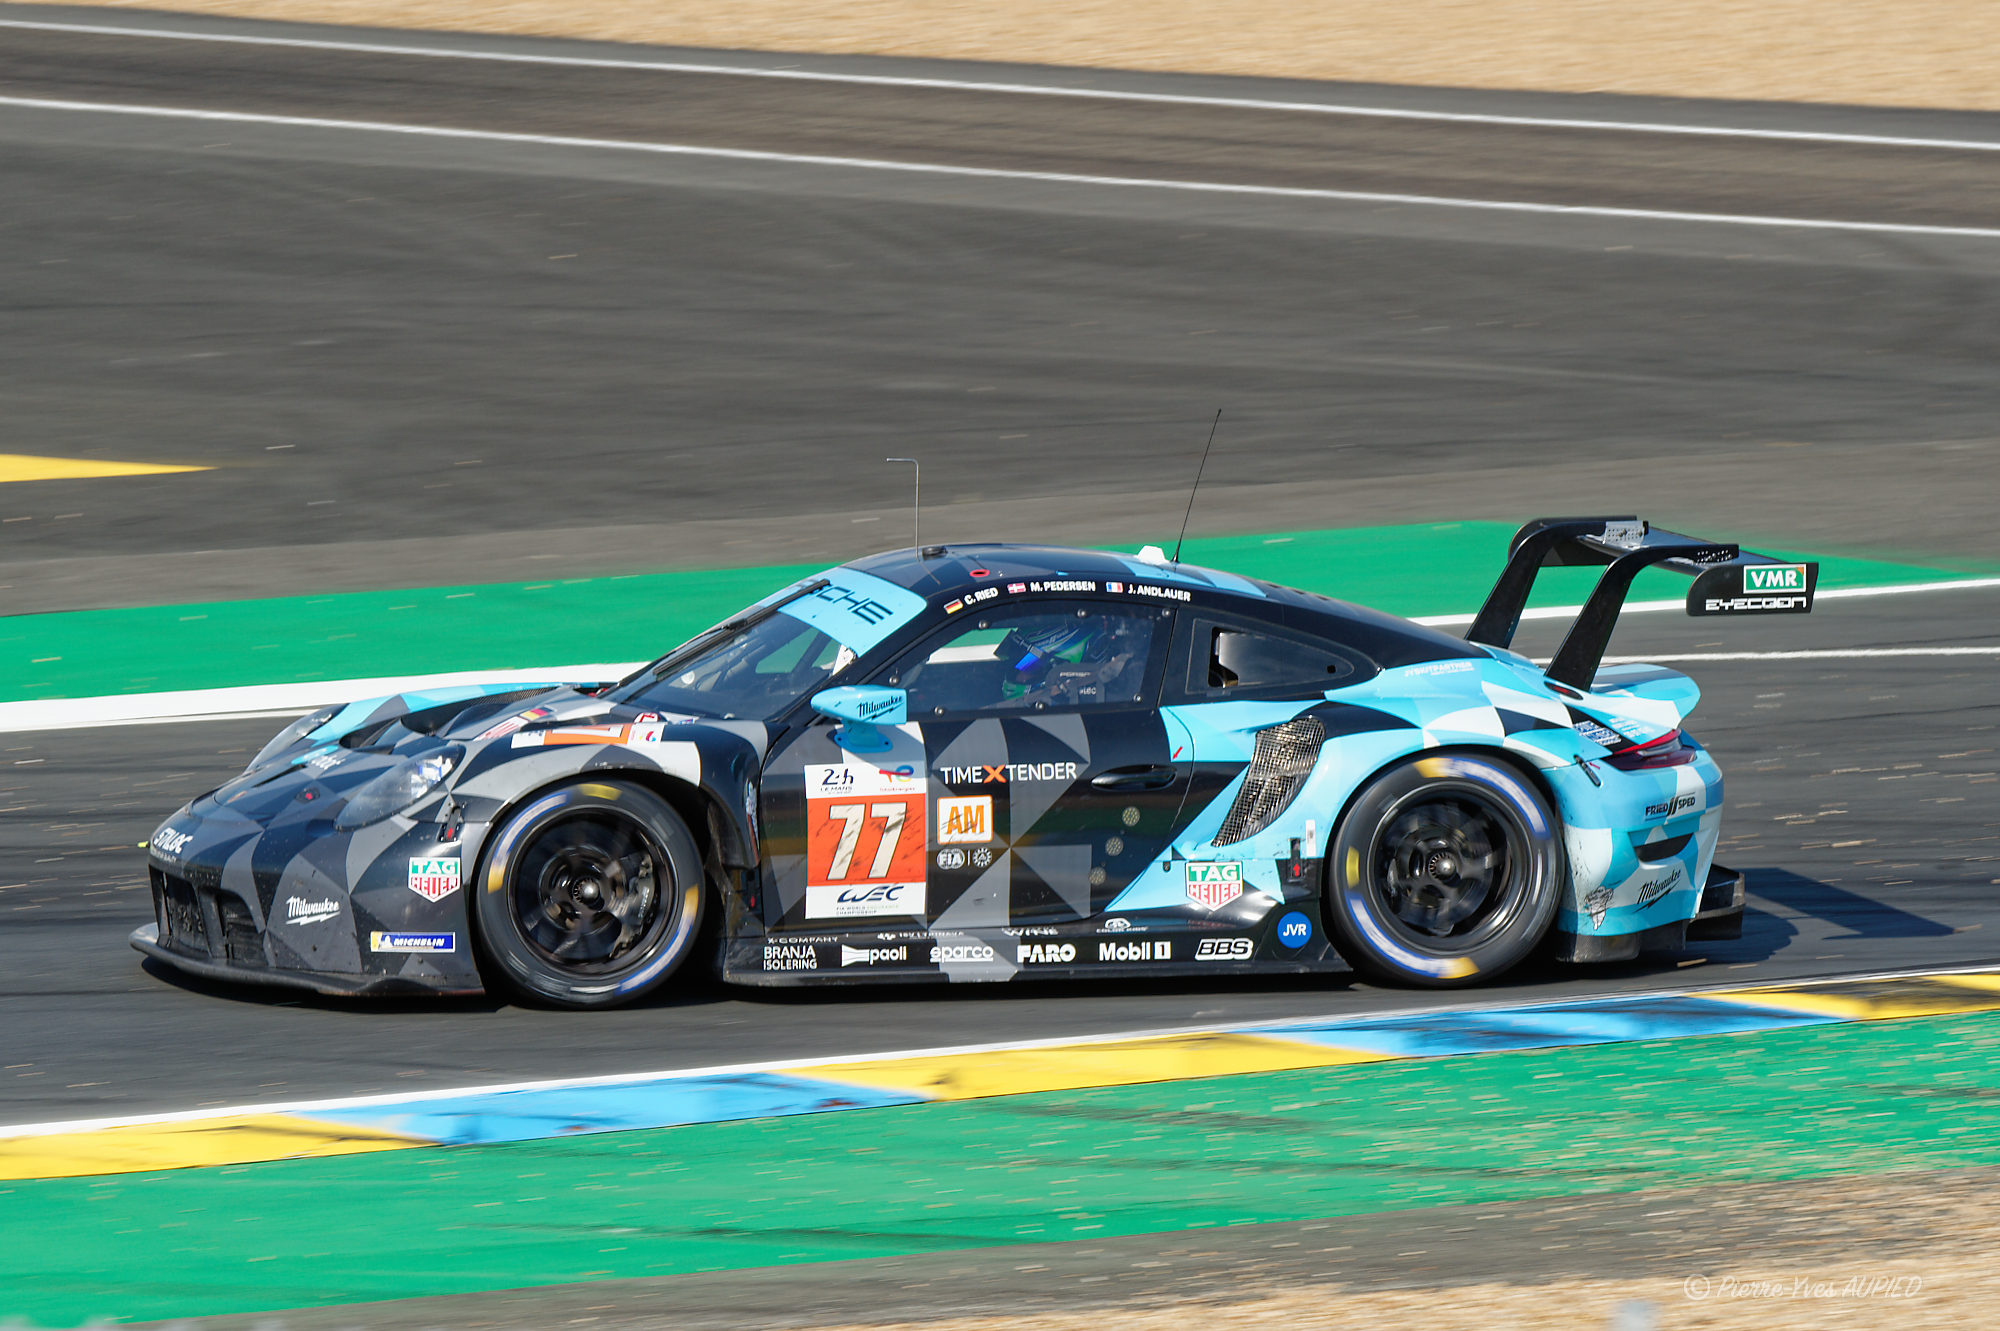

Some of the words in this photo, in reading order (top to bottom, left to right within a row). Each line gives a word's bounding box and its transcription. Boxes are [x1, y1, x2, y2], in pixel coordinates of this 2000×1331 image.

[1030, 581, 1043, 593] M.
[1043, 580, 1097, 593] PEDERSEN
[1750, 569, 1798, 588] VMR
[963, 593, 977, 606] C.
[976, 587, 999, 601] RIED
[1128, 583, 1138, 595] J.
[1137, 584, 1191, 603] ANDLAUER
[856, 695, 903, 718] Milwaukee
[940, 761, 1078, 786] TIMEXTENDER
[1645, 802, 1668, 817] FRIED
[1678, 796, 1696, 810] SPED
[946, 804, 985, 835] AM
[826, 802, 908, 880] 77
[412, 860, 456, 874] TAG
[938, 851, 964, 867] FIA
[1190, 865, 1238, 882] TAG
[411, 876, 457, 899] HEUER
[836, 885, 905, 904] WEC
[1189, 883, 1240, 909] HEUER
[1636, 868, 1682, 905] Milwaukee
[286, 895, 340, 919] Milwaukee
[1282, 923, 1308, 938] JVR
[393, 937, 445, 947] MICHELIN
[763, 944, 817, 960] BRANJA
[1098, 941, 1151, 962] Mobil
[1195, 938, 1253, 960] BBS
[929, 945, 994, 963] sparco
[1016, 943, 1077, 964] FARO
[763, 957, 818, 971] ISOLERING
